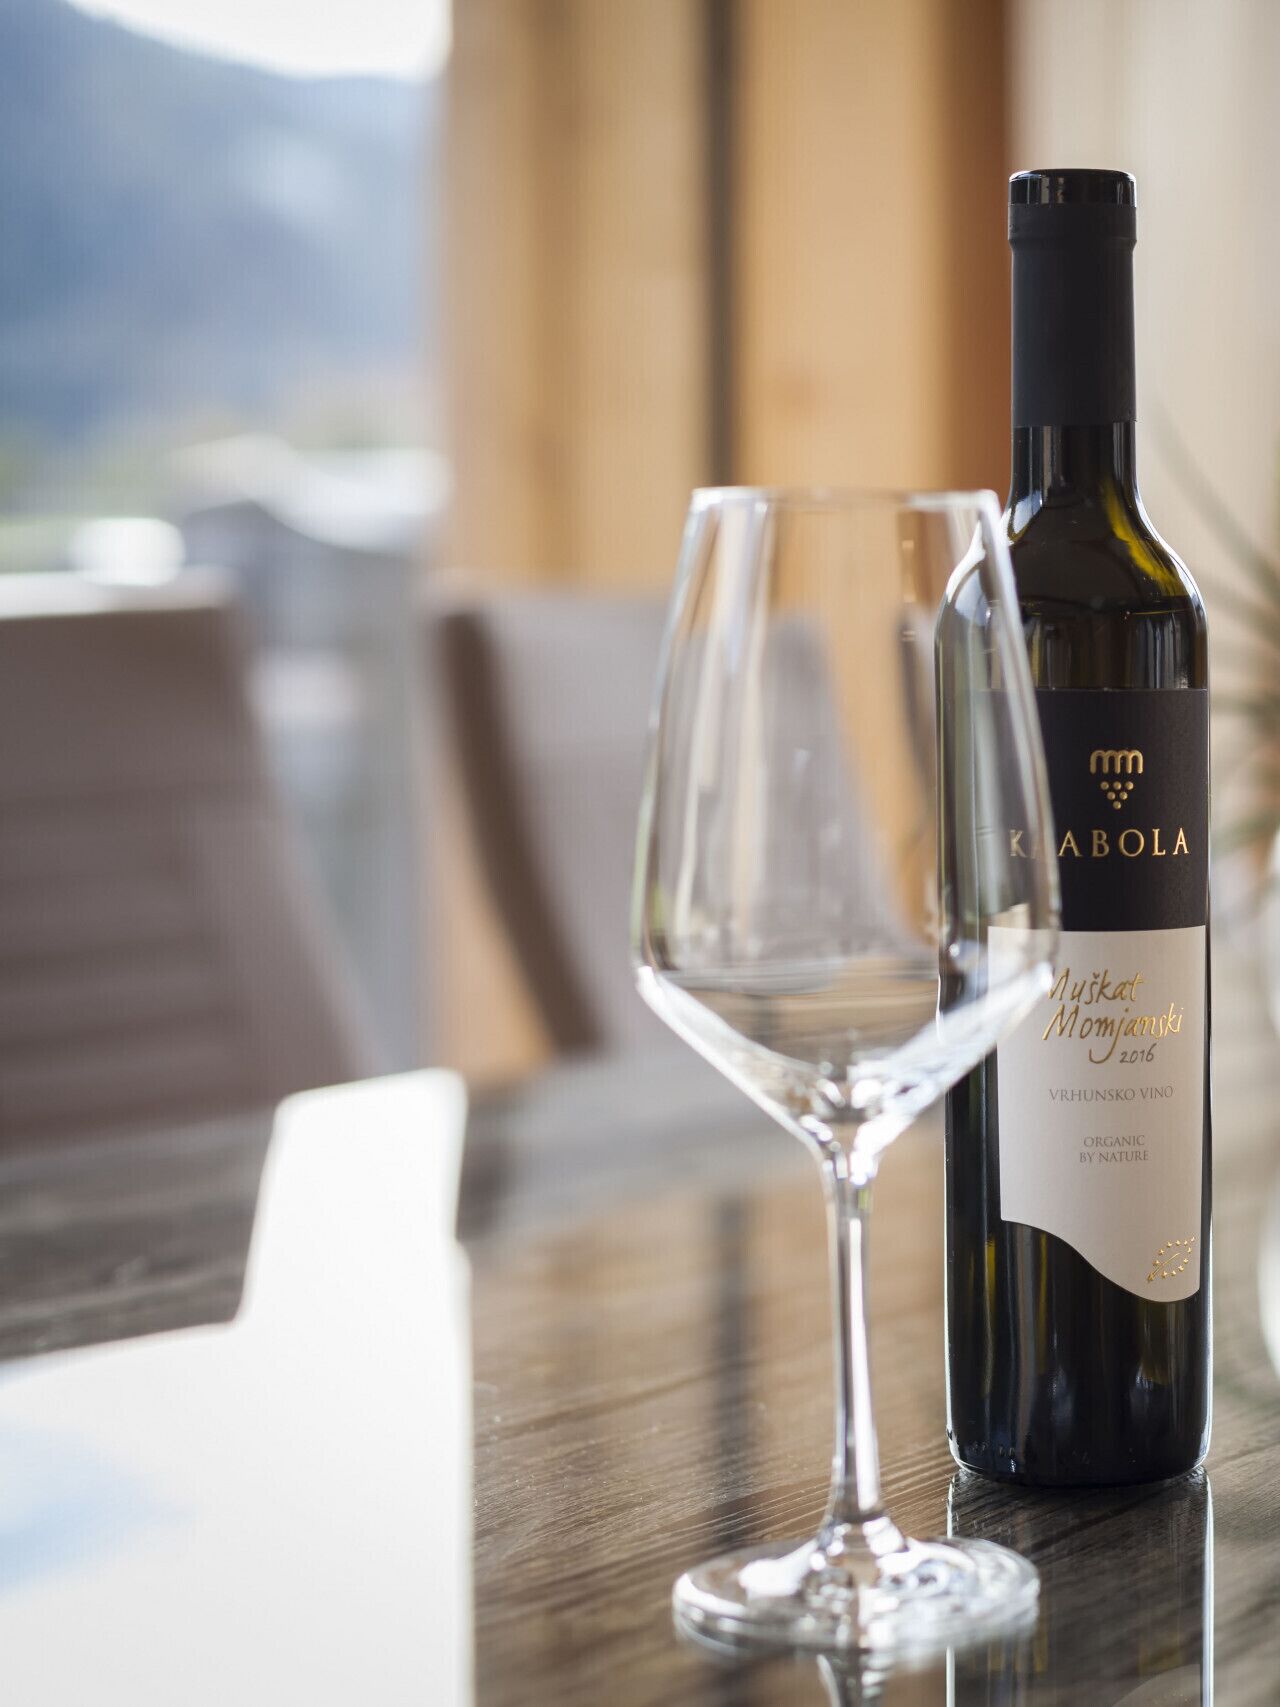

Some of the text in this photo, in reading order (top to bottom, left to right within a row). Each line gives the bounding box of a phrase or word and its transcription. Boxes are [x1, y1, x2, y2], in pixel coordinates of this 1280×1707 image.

[1042, 1002, 1184, 1064] Momjanski
[1120, 1043, 1155, 1064] 2016
[1050, 1085, 1174, 1102] VRHUNSKO VINO
[1083, 1135, 1146, 1148] ORGANIC
[1079, 1150, 1149, 1163] BY NATURE
